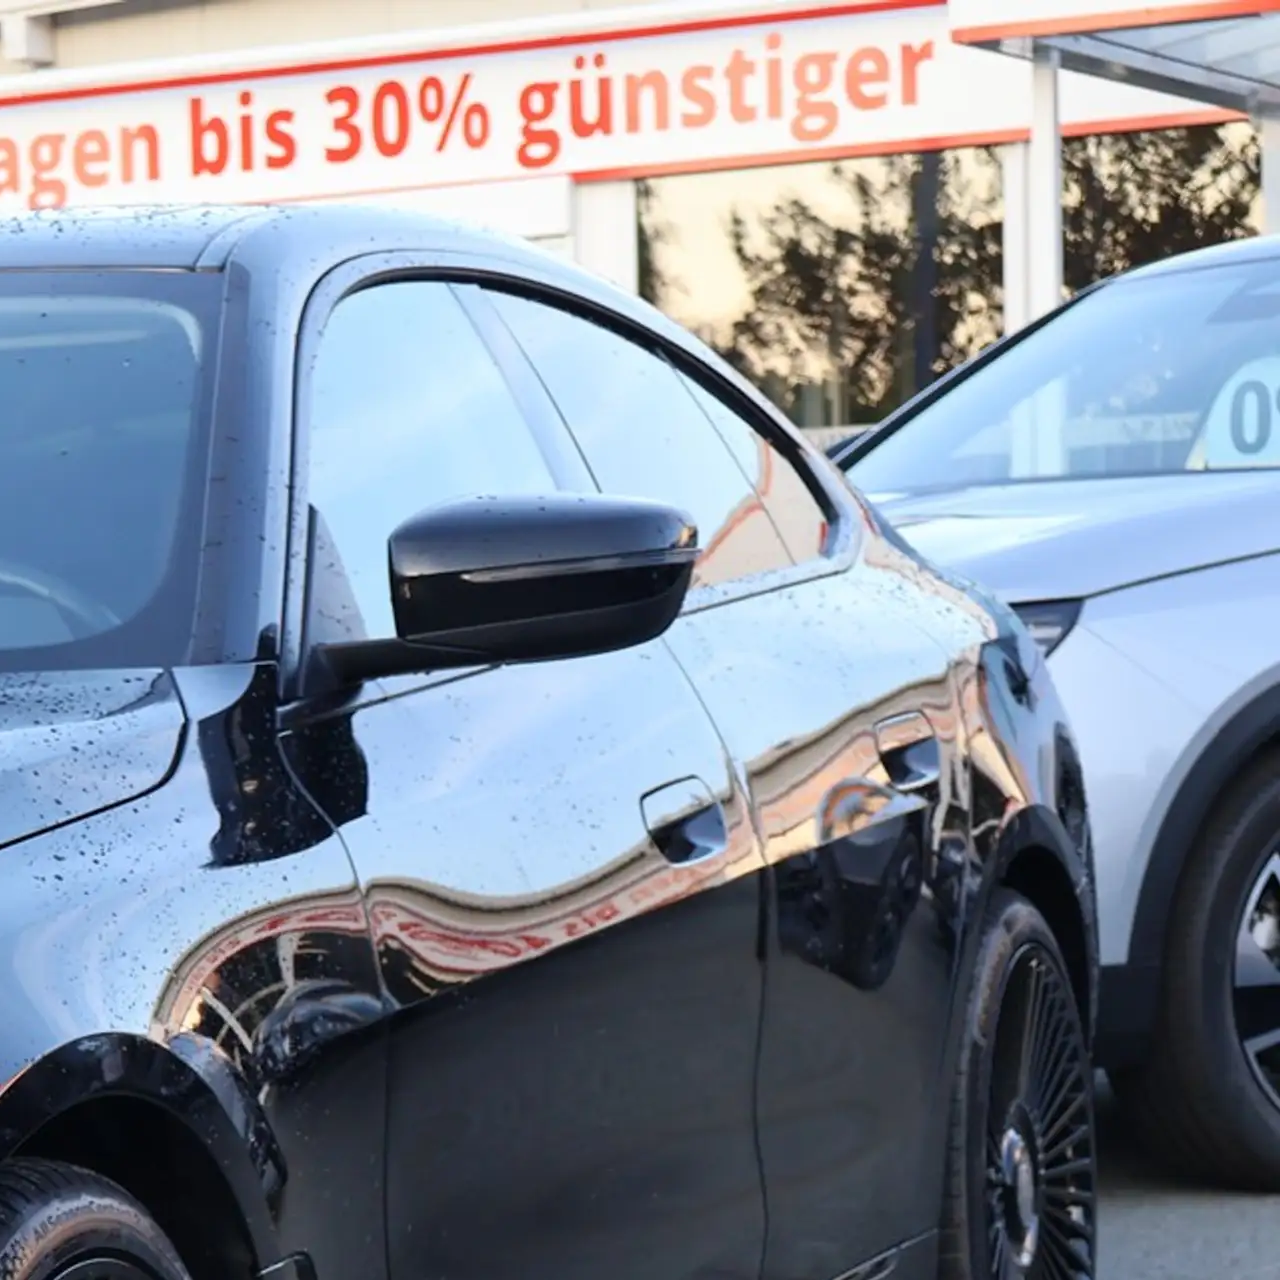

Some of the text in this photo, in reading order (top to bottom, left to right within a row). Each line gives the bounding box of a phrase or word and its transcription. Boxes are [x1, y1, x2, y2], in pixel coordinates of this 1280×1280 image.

[190, 91, 297, 176] bis
[324, 72, 490, 164] 30%
[516, 32, 934, 168] günstiger
[1229, 380, 1280, 455] 0
